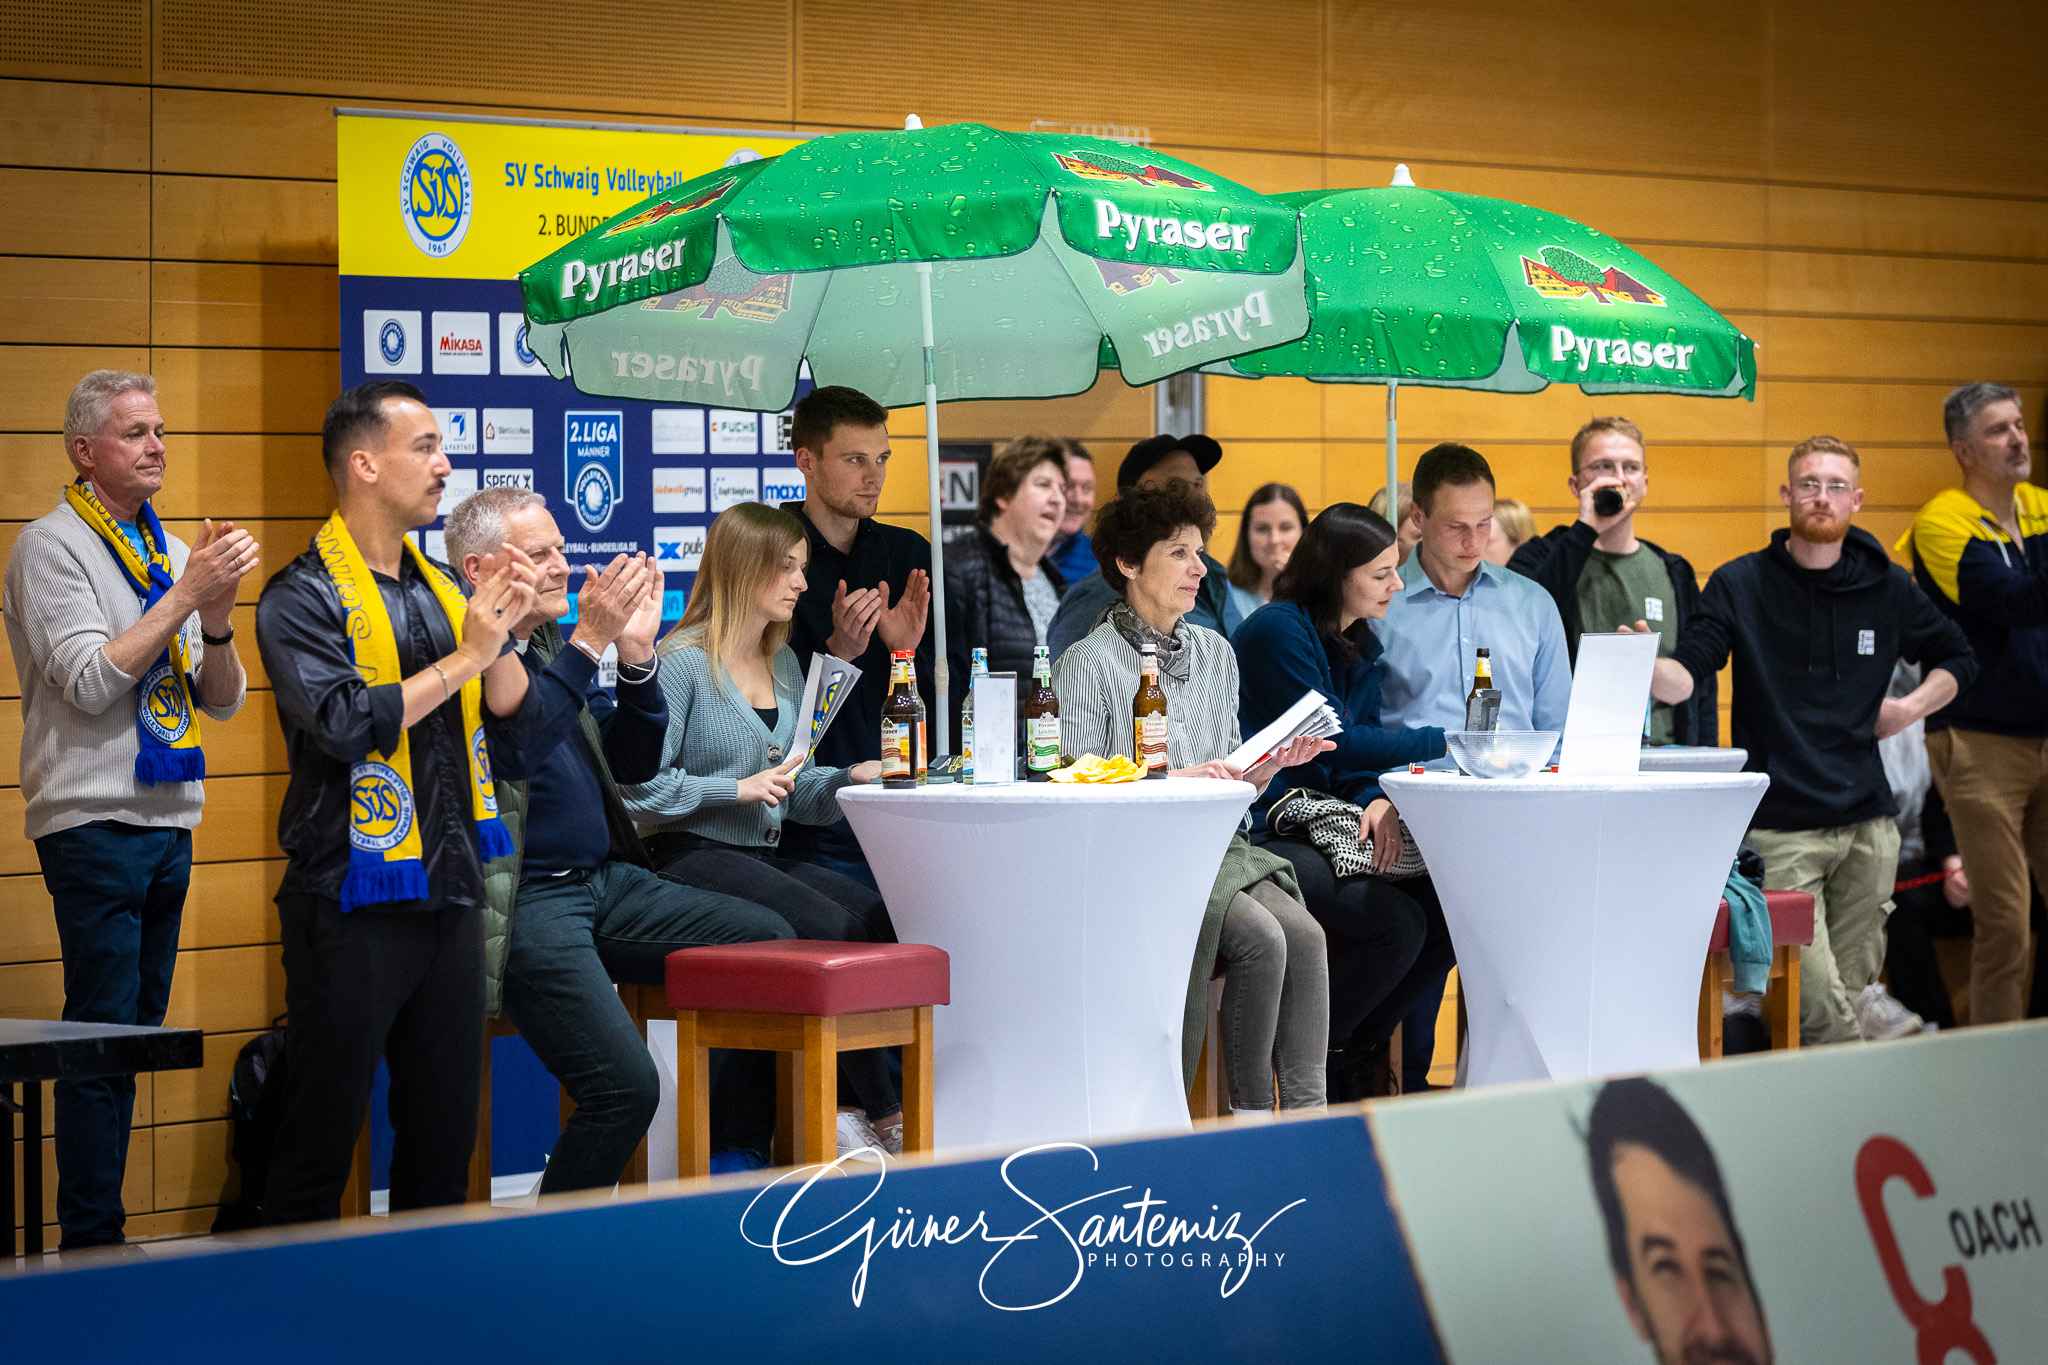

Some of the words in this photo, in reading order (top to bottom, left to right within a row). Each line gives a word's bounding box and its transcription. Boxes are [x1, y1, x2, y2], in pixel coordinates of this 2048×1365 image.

[402, 139, 430, 193] SCHWAIG
[505, 161, 527, 188] SV
[534, 163, 600, 197] Schwaig
[606, 166, 683, 198] Volleyball
[428, 242, 447, 254] 1967
[538, 214, 552, 236] 2.
[1096, 198, 1252, 253] Pyraser
[561, 238, 687, 303] Pyraser
[1551, 325, 1696, 373] Pyraser
